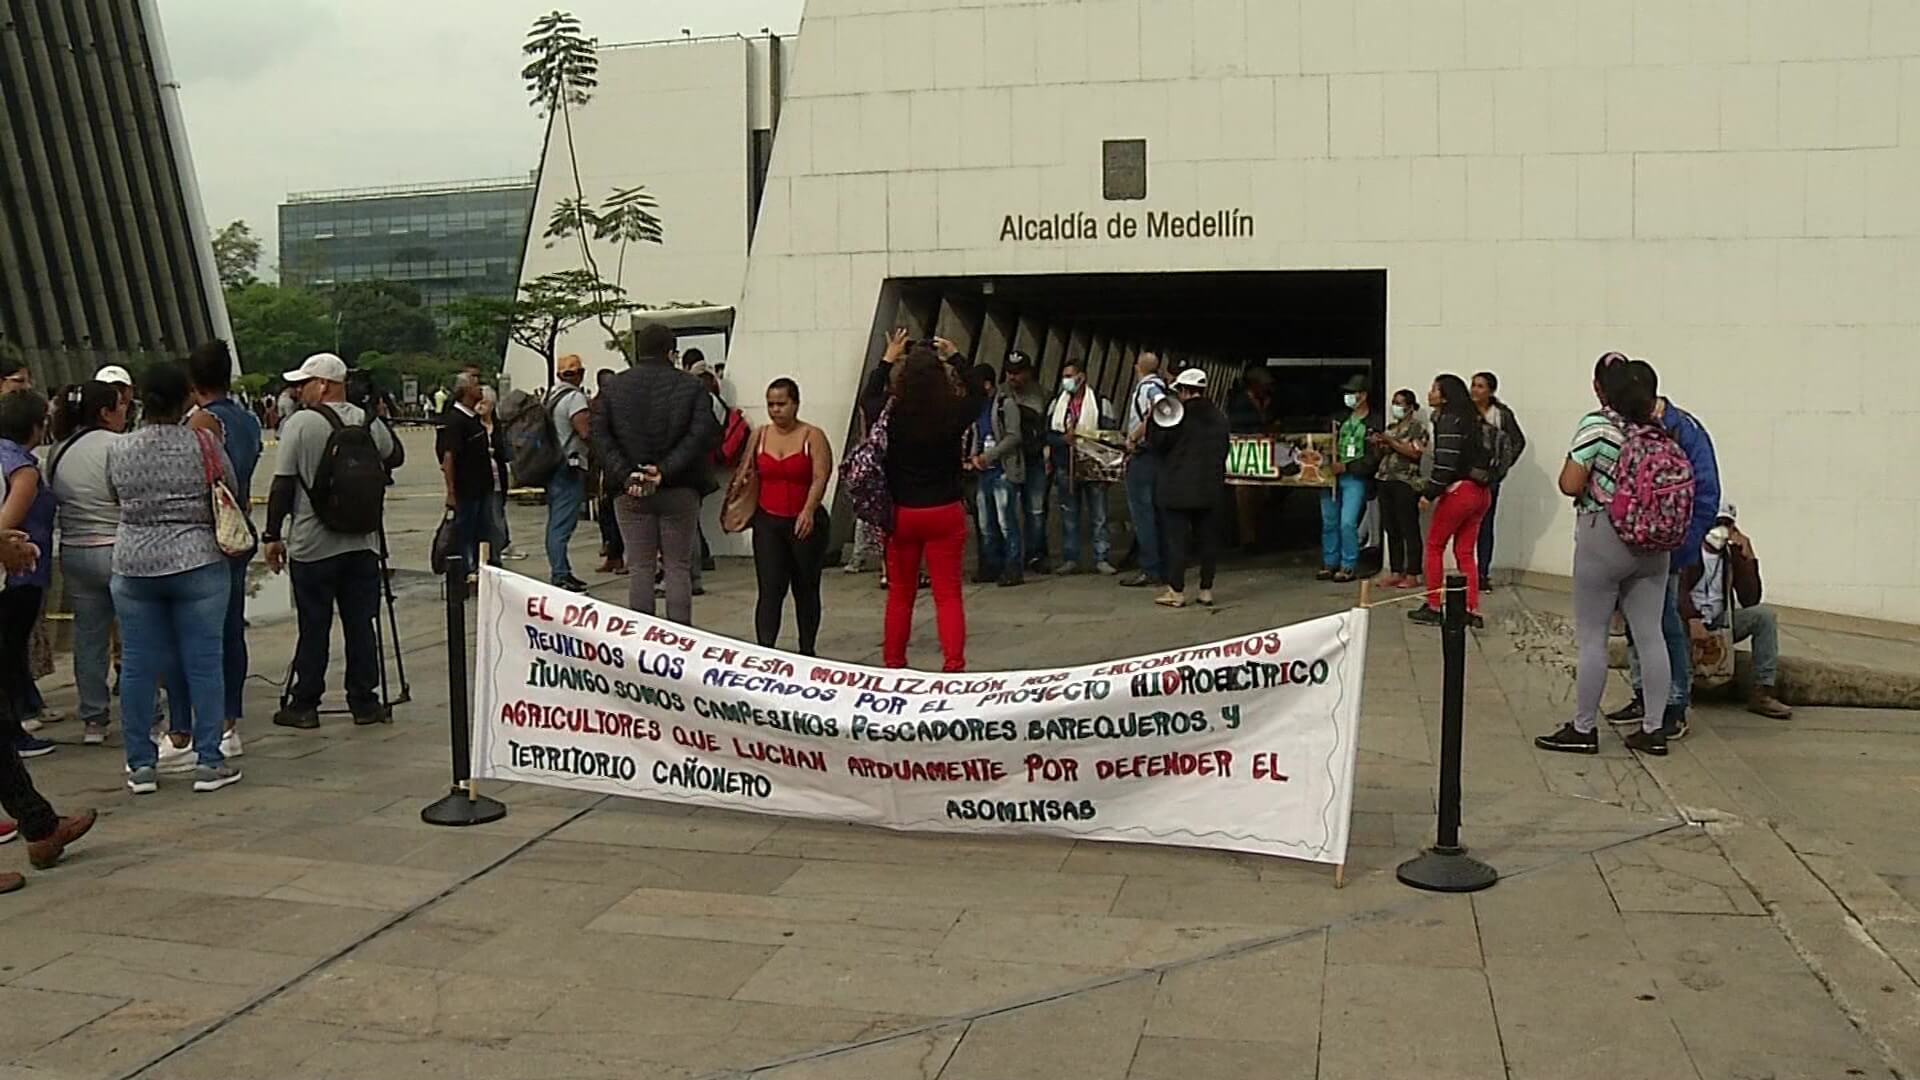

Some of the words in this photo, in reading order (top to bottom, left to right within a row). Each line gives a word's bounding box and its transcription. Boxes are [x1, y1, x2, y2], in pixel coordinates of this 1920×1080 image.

[1000, 210, 1098, 241] Alcaldía
[1107, 212, 1137, 239] de
[1147, 208, 1254, 238] Medellín
[525, 624, 625, 668] REUNIDOS
[638, 650, 685, 680] LOS
[703, 668, 837, 701] AFECTADOS
[854, 692, 907, 715] POR
[919, 700, 954, 713] EL
[976, 680, 1111, 707] PROYECTO
[527, 596, 553, 621] EL
[563, 603, 599, 629] DÍA
[606, 616, 638, 636] DE
[643, 625, 698, 651] HOY
[702, 646, 739, 665] EN
[741, 655, 795, 677] ESTA
[811, 666, 1009, 696] MOVILIZACIÓN
[1020, 672, 1071, 687] NOS
[1092, 632, 1281, 676] ENCONTRAMOS
[526, 657, 610, 695] ITUANGO
[614, 680, 685, 711] SOMOS
[694, 696, 839, 737] CAMPESINOS
[501, 700, 661, 741] AGRICULTORES
[672, 726, 721, 751] QUE
[732, 737, 827, 772] LUCHAN
[848, 756, 1008, 782] ARDUAMENTE
[1024, 753, 1078, 782] POR
[1095, 750, 1233, 780] DEFENDER
[1252, 753, 1289, 782] EL
[508, 740, 636, 780] TERRITORIO
[652, 757, 771, 798] CAÑONERO
[946, 800, 1097, 822] ASOMINSAB
